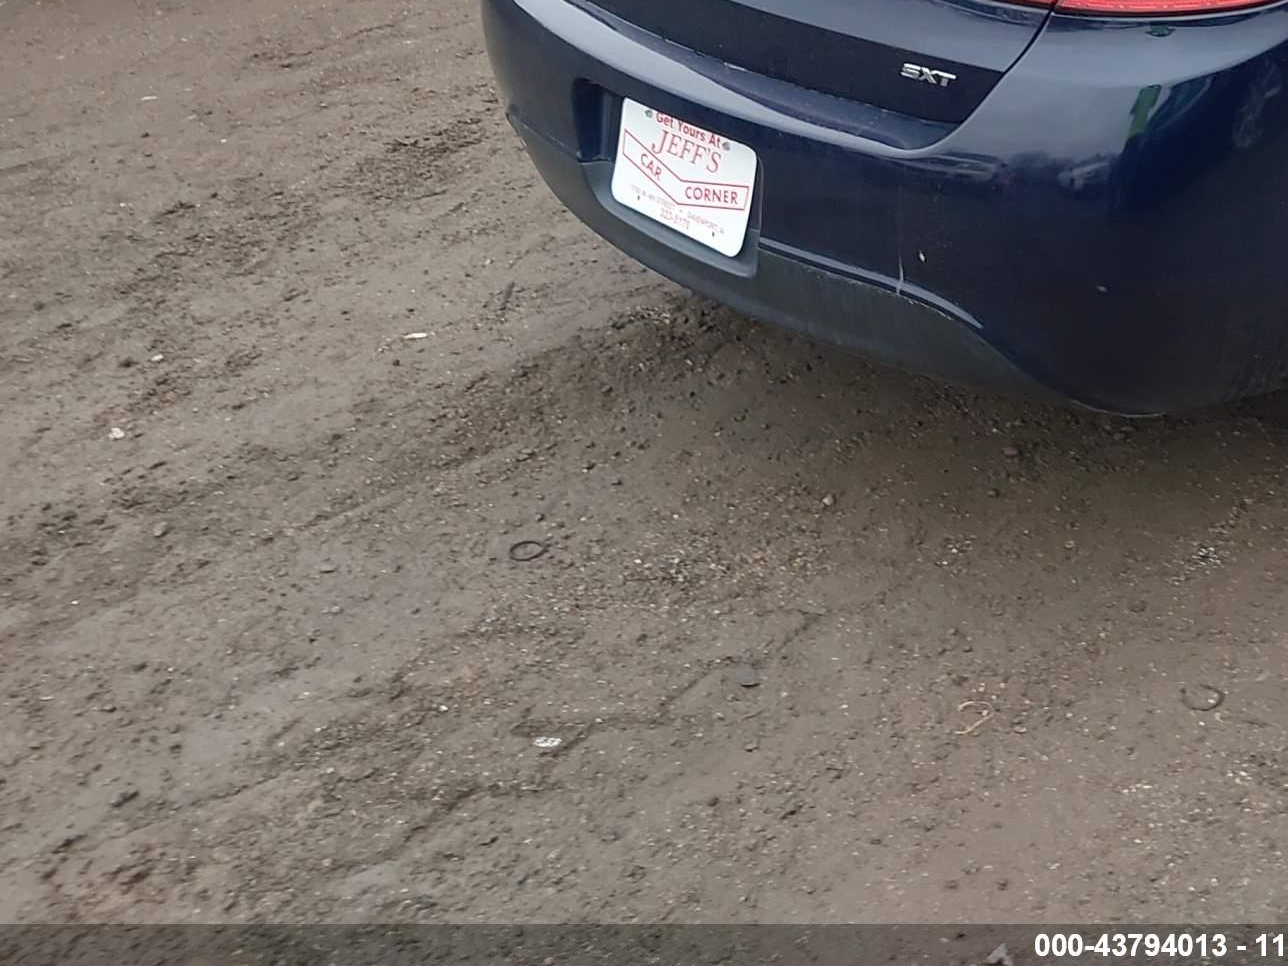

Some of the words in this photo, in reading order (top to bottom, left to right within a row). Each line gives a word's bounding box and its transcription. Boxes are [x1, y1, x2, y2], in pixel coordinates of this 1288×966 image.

[900, 62, 957, 87] SXT
[656, 112, 674, 129] Get
[678, 121, 706, 141] Yours
[709, 135, 722, 148] At
[651, 129, 722, 173] JEFF'S
[640, 153, 662, 181] CAR
[685, 186, 739, 205] CORNER
